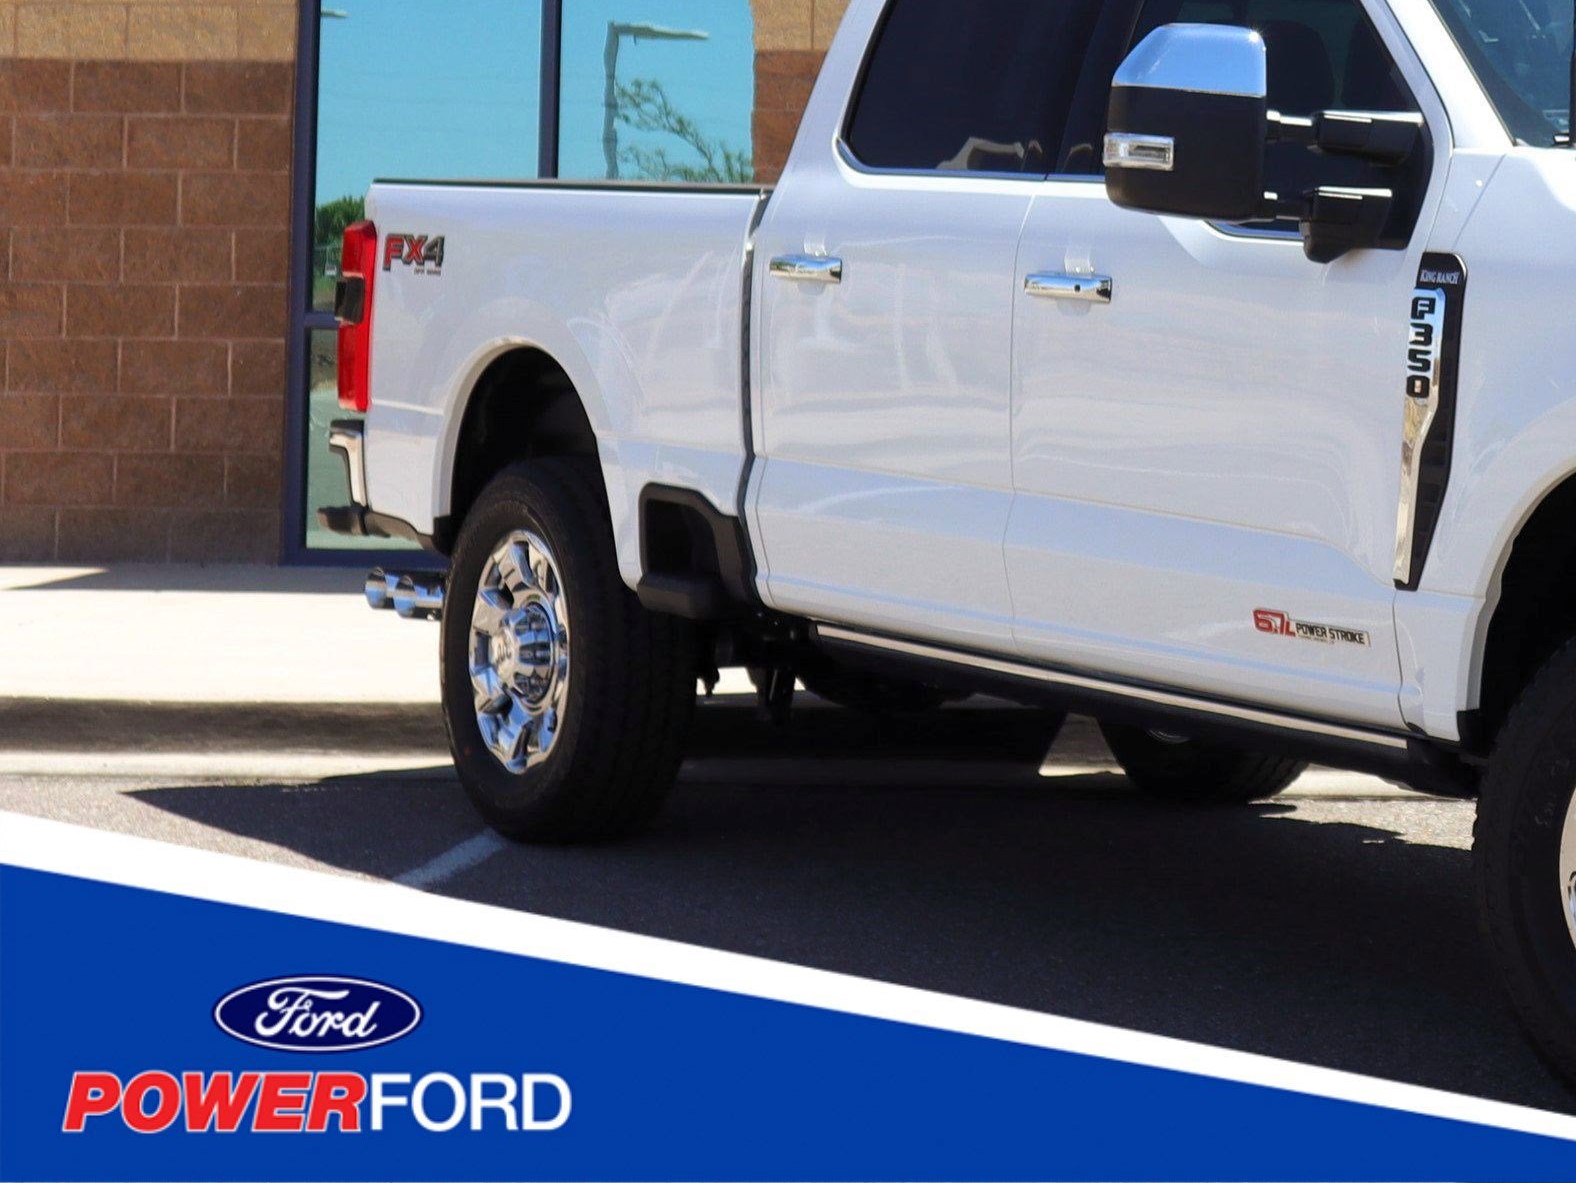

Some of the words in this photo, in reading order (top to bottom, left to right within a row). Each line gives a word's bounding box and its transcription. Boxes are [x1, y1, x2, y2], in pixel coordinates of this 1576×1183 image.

[382, 233, 446, 273] FX4
[1406, 296, 1436, 399] F350
[1295, 621, 1328, 639] POWER
[1328, 628, 1366, 646] STROKE
